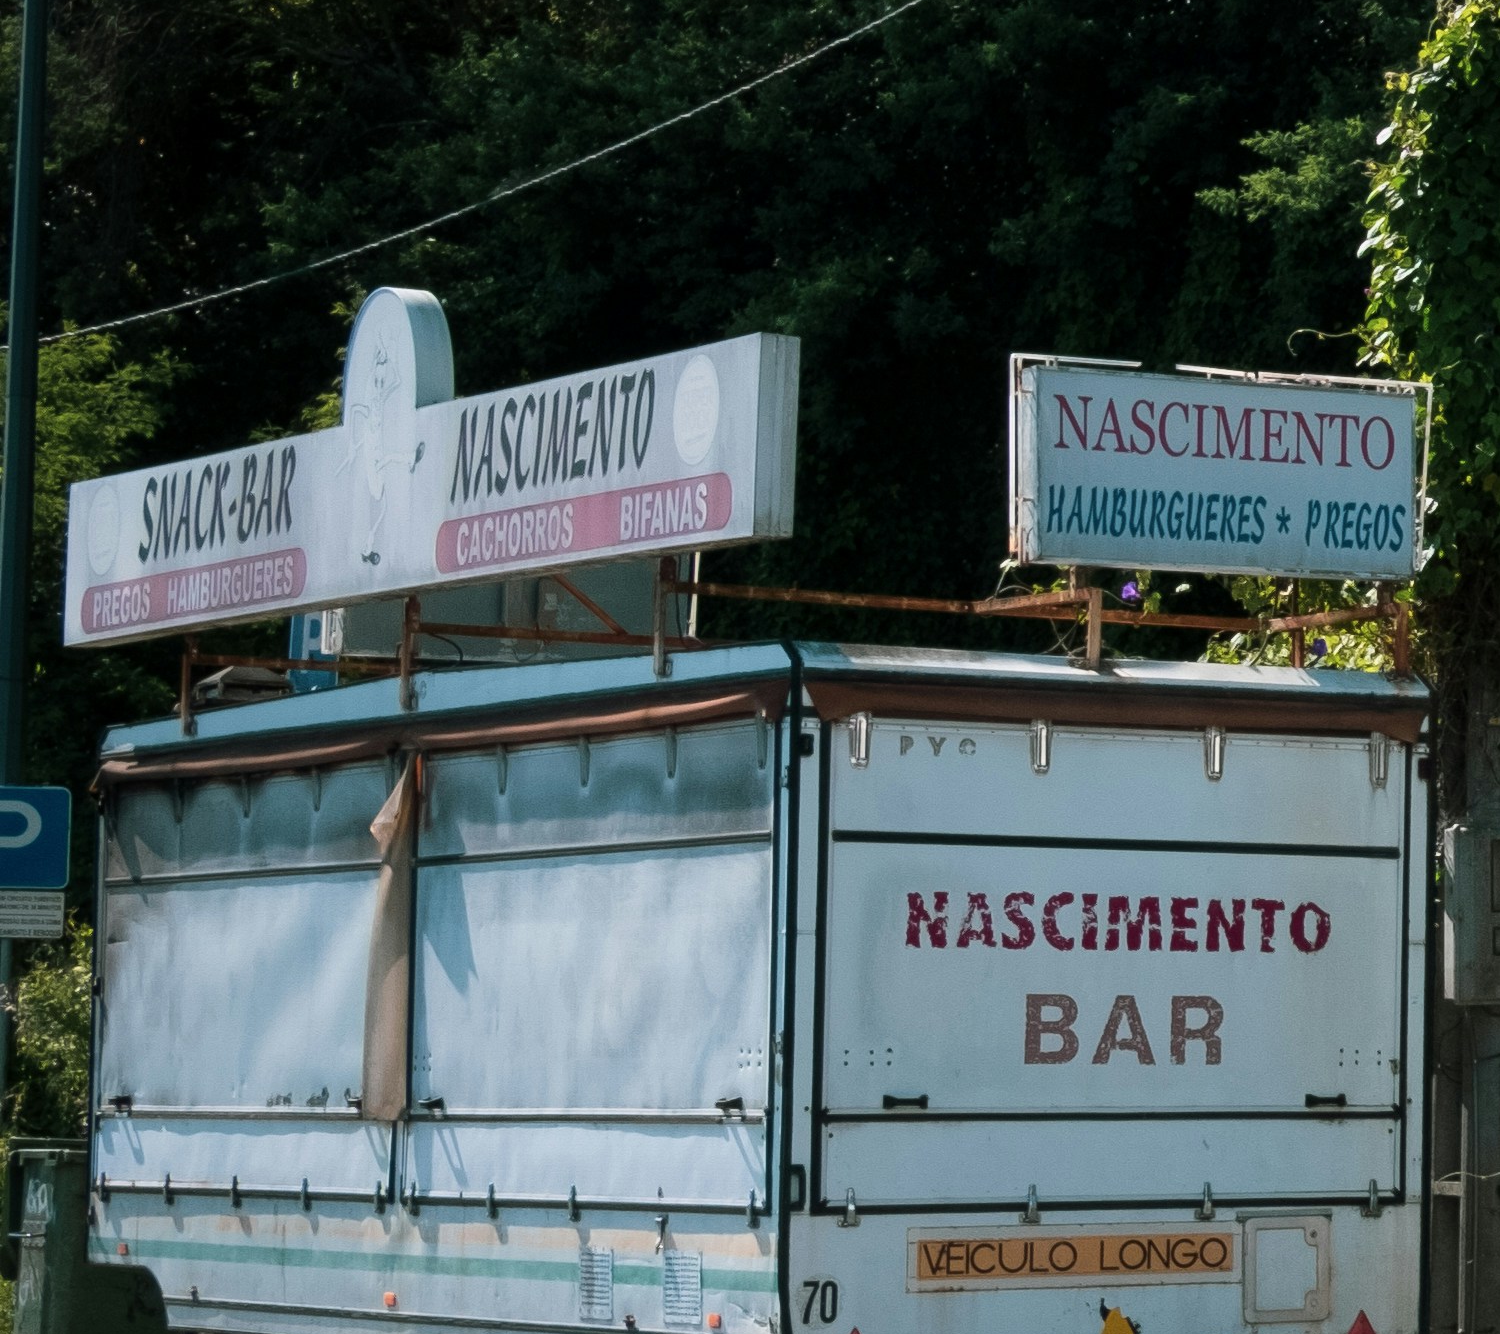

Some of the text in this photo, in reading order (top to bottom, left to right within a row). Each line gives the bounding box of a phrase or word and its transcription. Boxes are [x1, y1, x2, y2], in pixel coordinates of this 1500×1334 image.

[450, 368, 656, 502] NASCIMENTO
[1053, 393, 1395, 471] NASCIMENTO
[137, 445, 296, 565] SNACK-BAR
[455, 481, 709, 567] CACHORROS BIFANAS
[1046, 484, 1406, 554] HAMBURGUERES PREGOS
[91, 556, 295, 631] PREGOS HAMBURGUERES
[905, 892, 1332, 954] NASCIMENTO
[1023, 993, 1224, 1066] BAR
[922, 1237, 1228, 1275] VEICULO LONGO
[801, 1279, 838, 1325] 70
